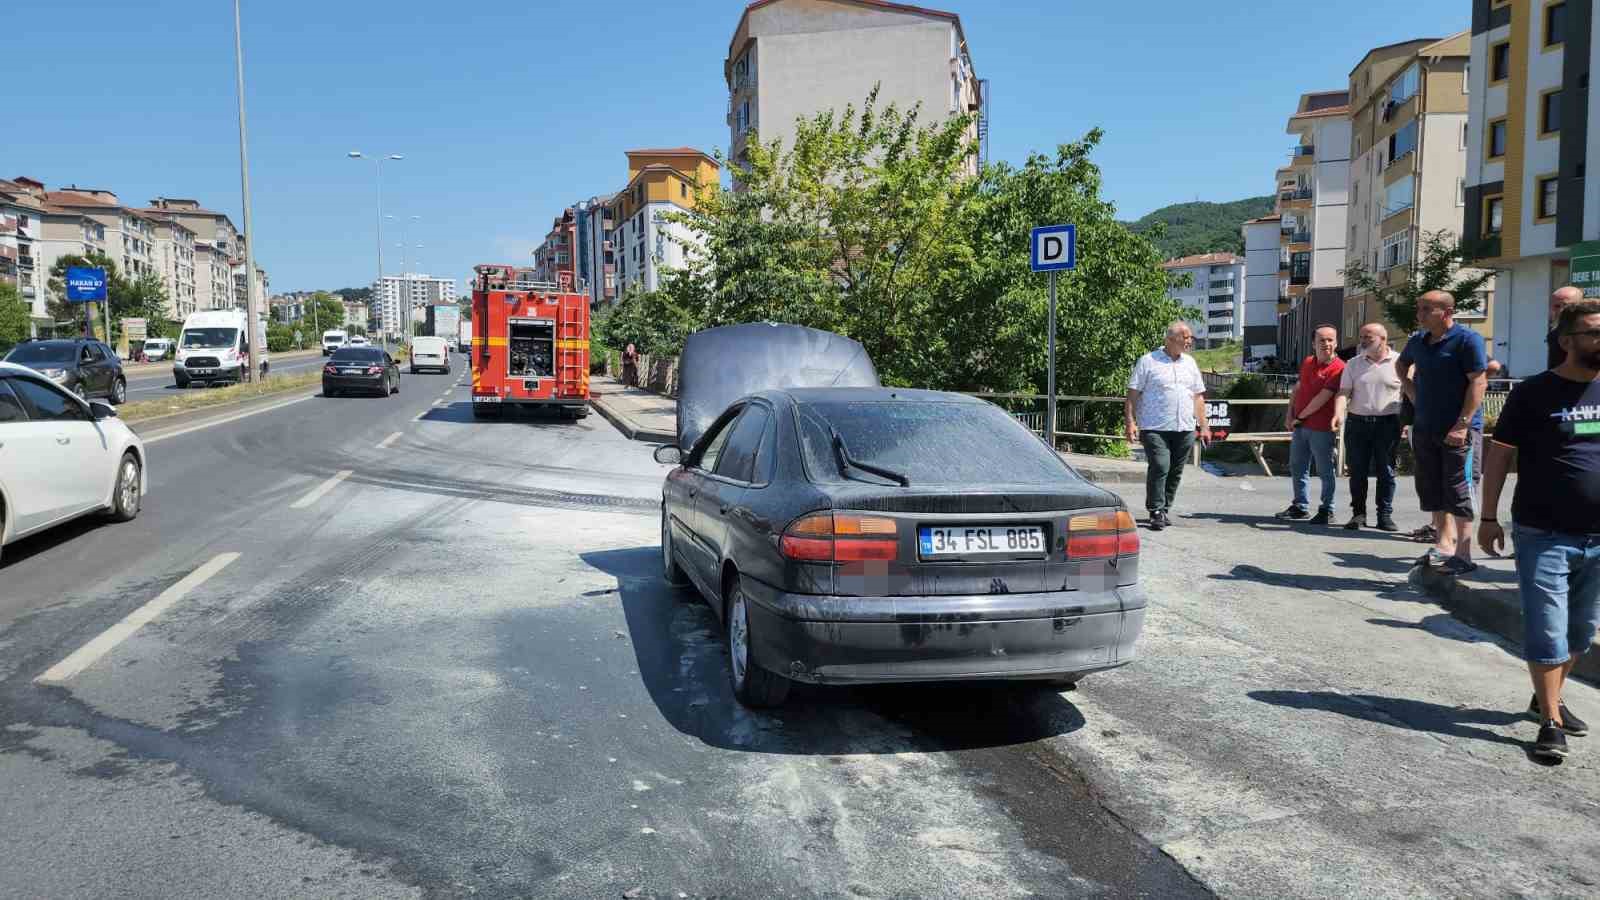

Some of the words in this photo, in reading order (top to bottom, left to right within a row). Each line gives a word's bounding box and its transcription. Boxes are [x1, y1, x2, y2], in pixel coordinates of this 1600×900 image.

[1043, 236, 1062, 260] D
[934, 528, 957, 551] 34
[964, 529, 1000, 550] FSL
[1006, 528, 1040, 550] 885
